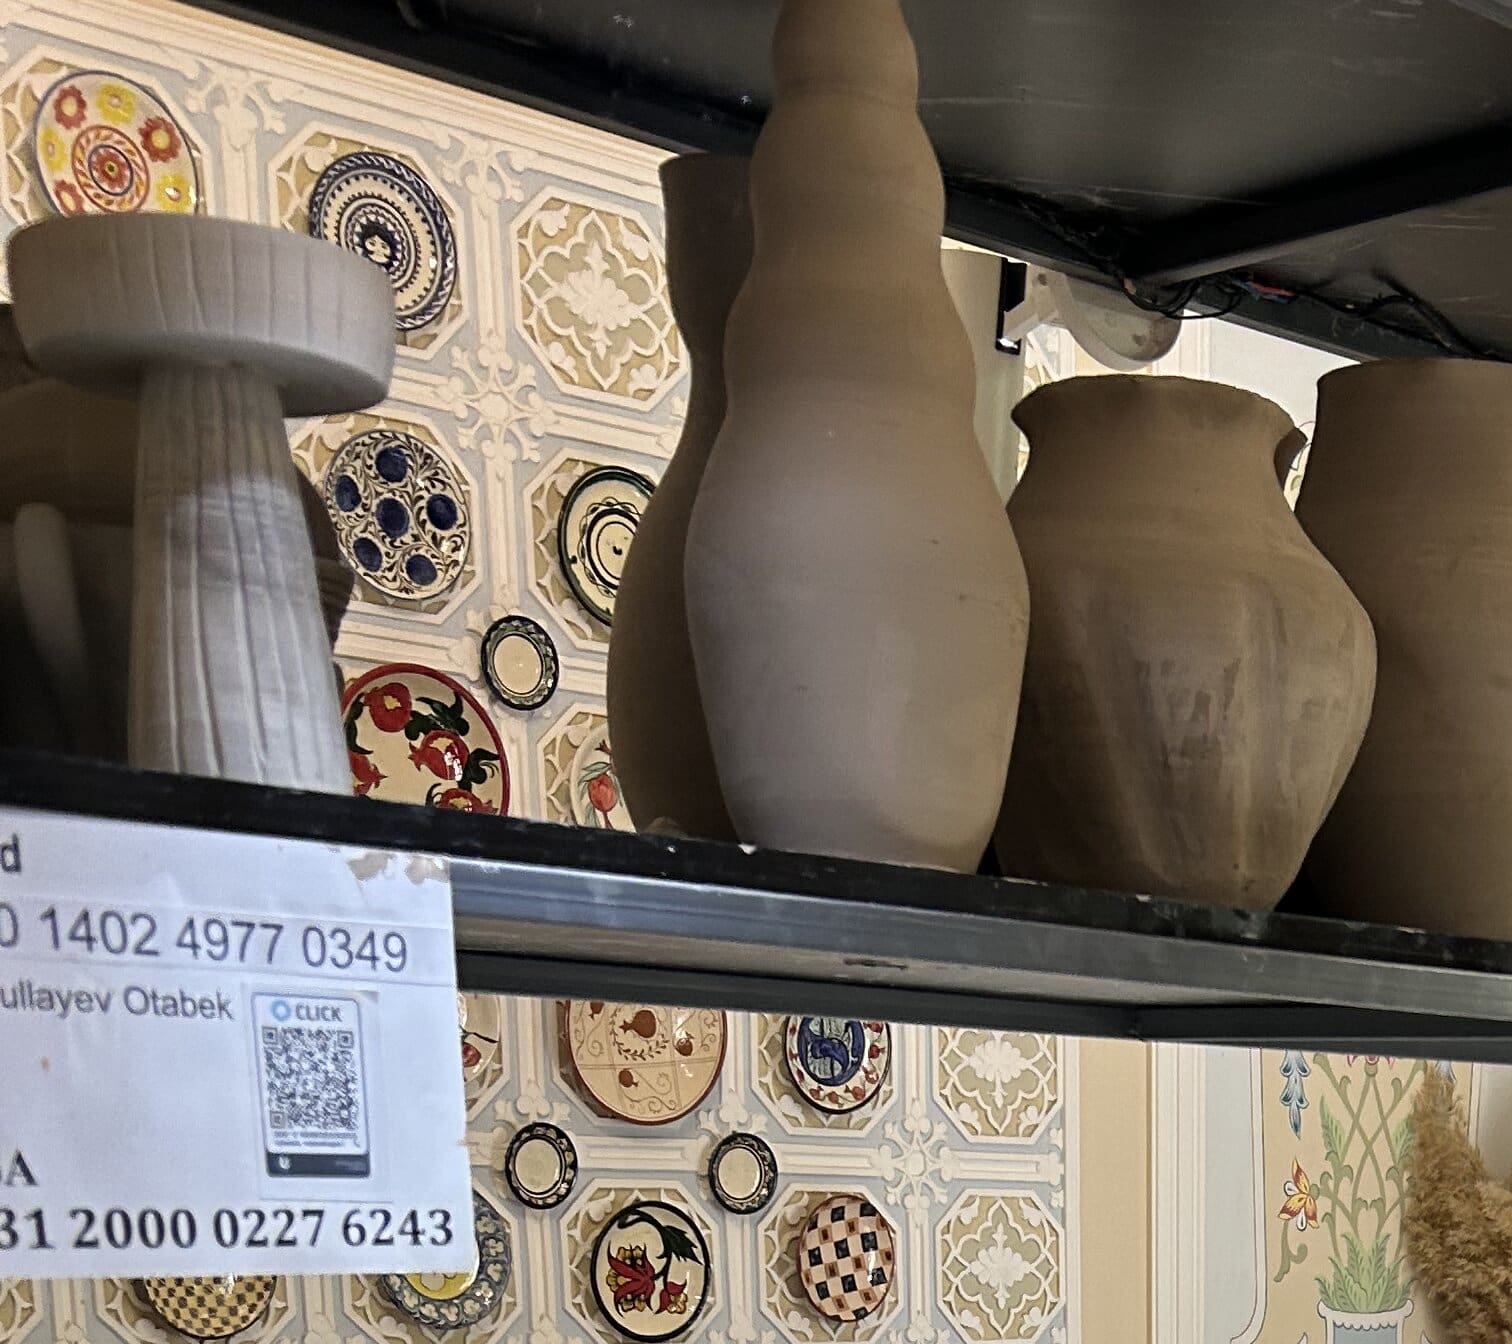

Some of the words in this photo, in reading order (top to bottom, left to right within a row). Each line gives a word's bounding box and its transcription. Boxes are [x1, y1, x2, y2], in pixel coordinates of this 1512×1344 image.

[39, 905, 160, 955] 1402
[176, 917, 284, 965] 4977
[302, 926, 408, 973] 0349
[124, 985, 235, 1021] Otabek
[295, 1002, 343, 1022] CLICK
[69, 1207, 197, 1249] 2000
[213, 1208, 325, 1249] 0227
[342, 1208, 454, 1248] 6243
